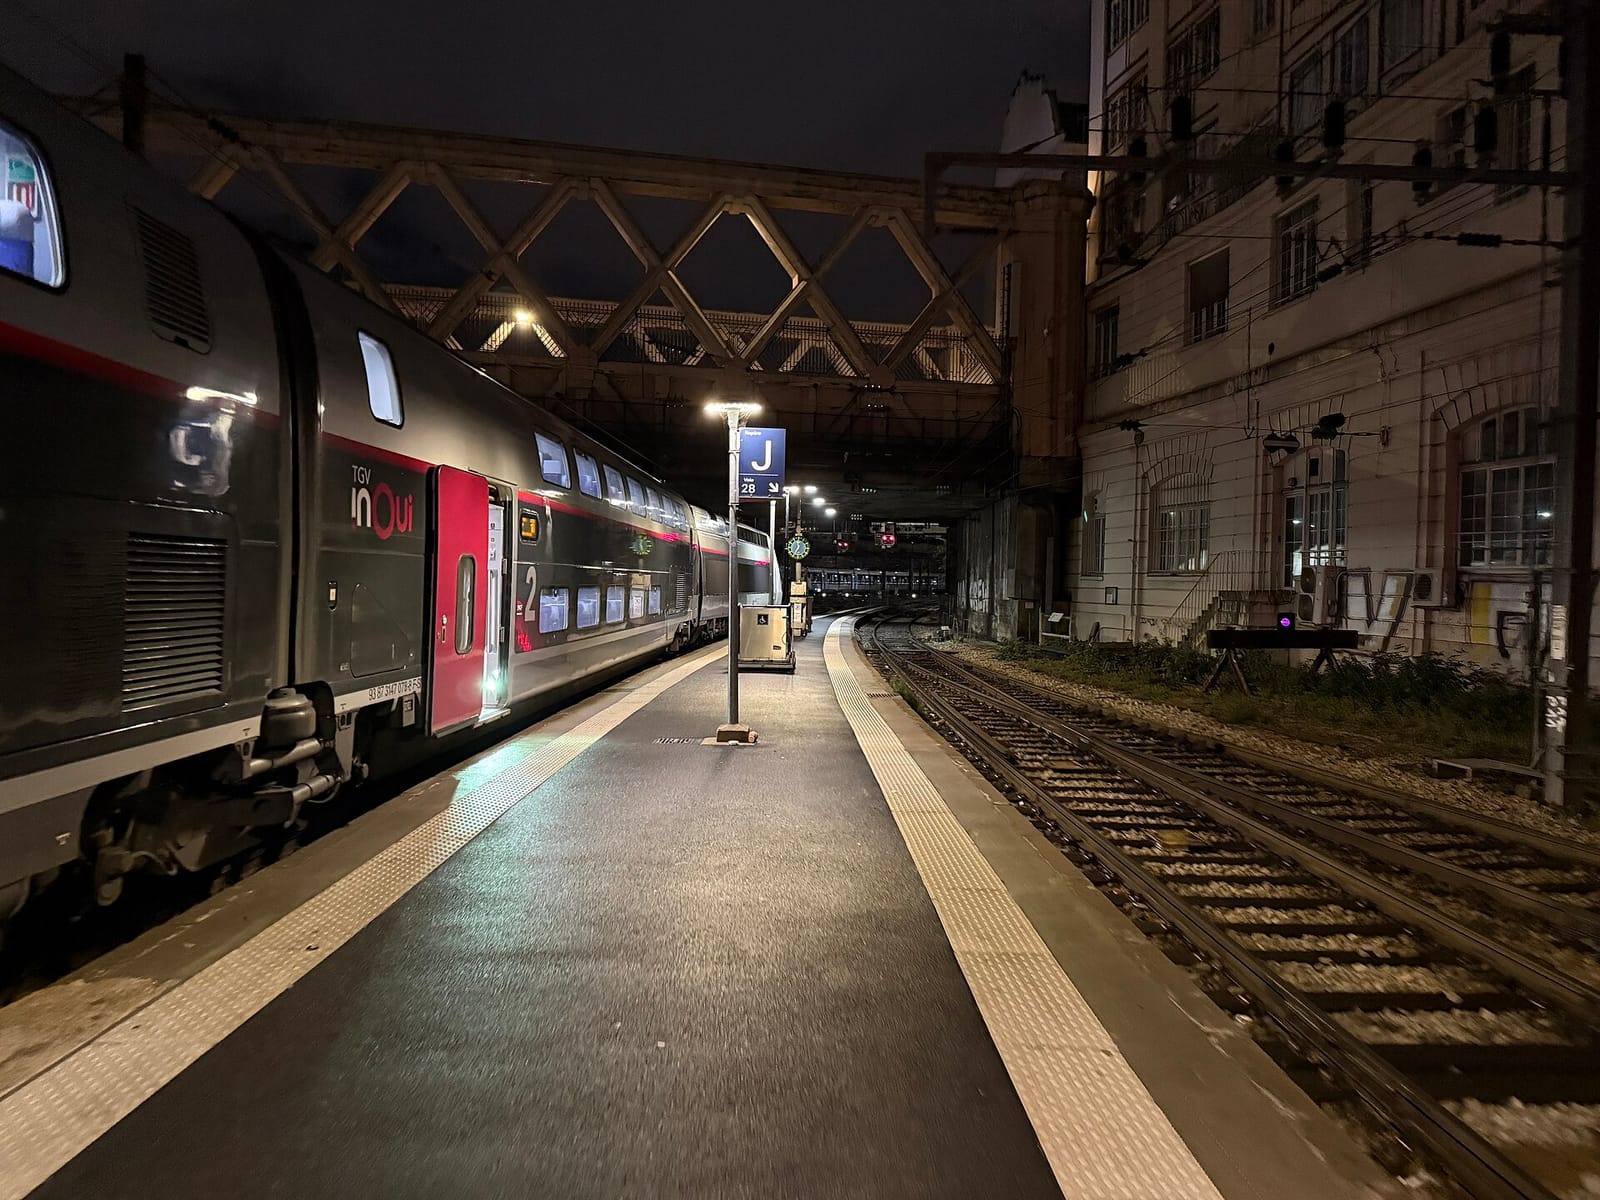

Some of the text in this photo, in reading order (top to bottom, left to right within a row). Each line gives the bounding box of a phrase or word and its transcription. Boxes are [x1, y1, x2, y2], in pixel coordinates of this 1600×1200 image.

[751, 440, 772, 471] J
[352, 464, 371, 485] TGV
[741, 483, 756, 494] 28
[525, 566, 537, 622] 2
